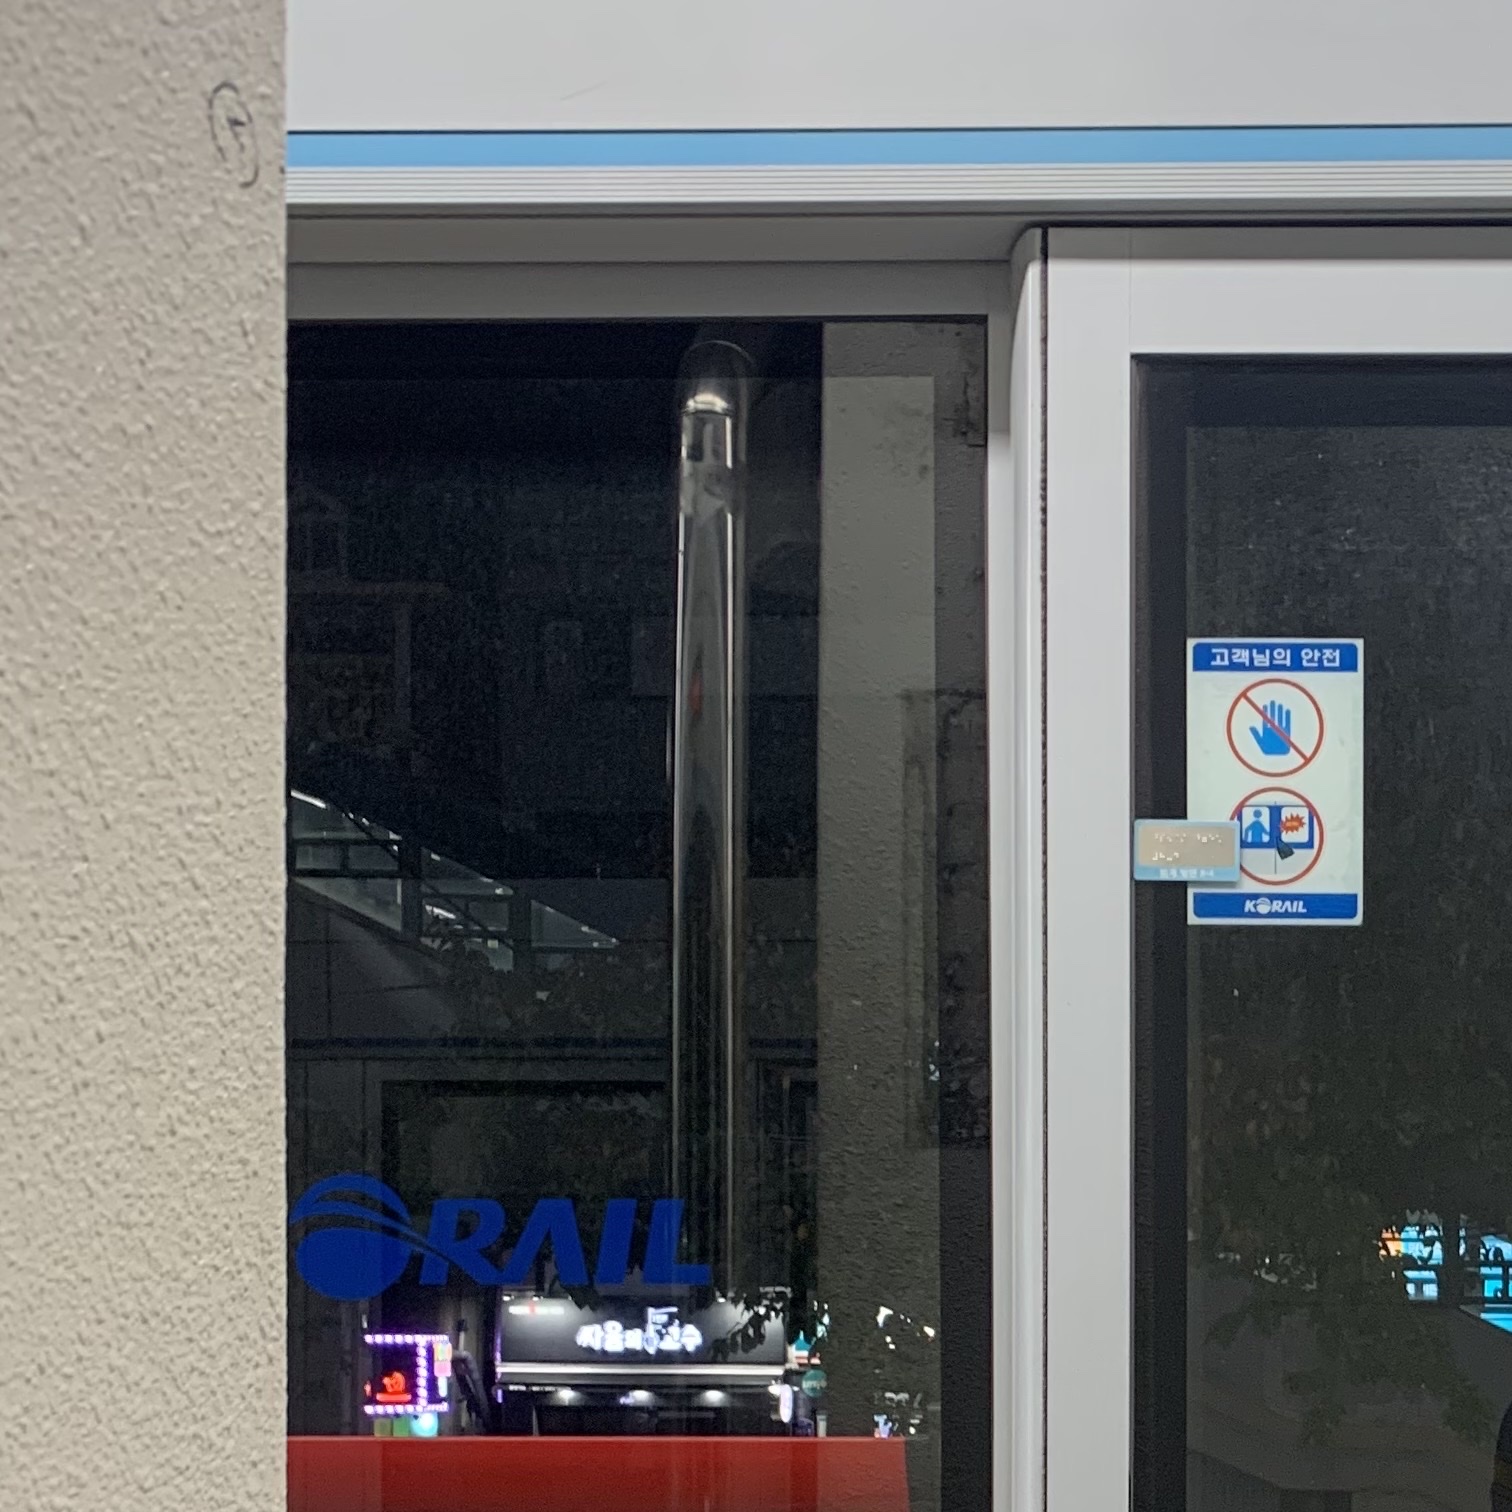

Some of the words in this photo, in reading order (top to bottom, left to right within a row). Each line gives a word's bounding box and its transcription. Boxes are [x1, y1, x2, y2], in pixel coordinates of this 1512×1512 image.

[1210, 648, 1292, 667] 고객님의
[1301, 647, 1341, 667] 안전
[1244, 897, 1307, 914] KORAIL
